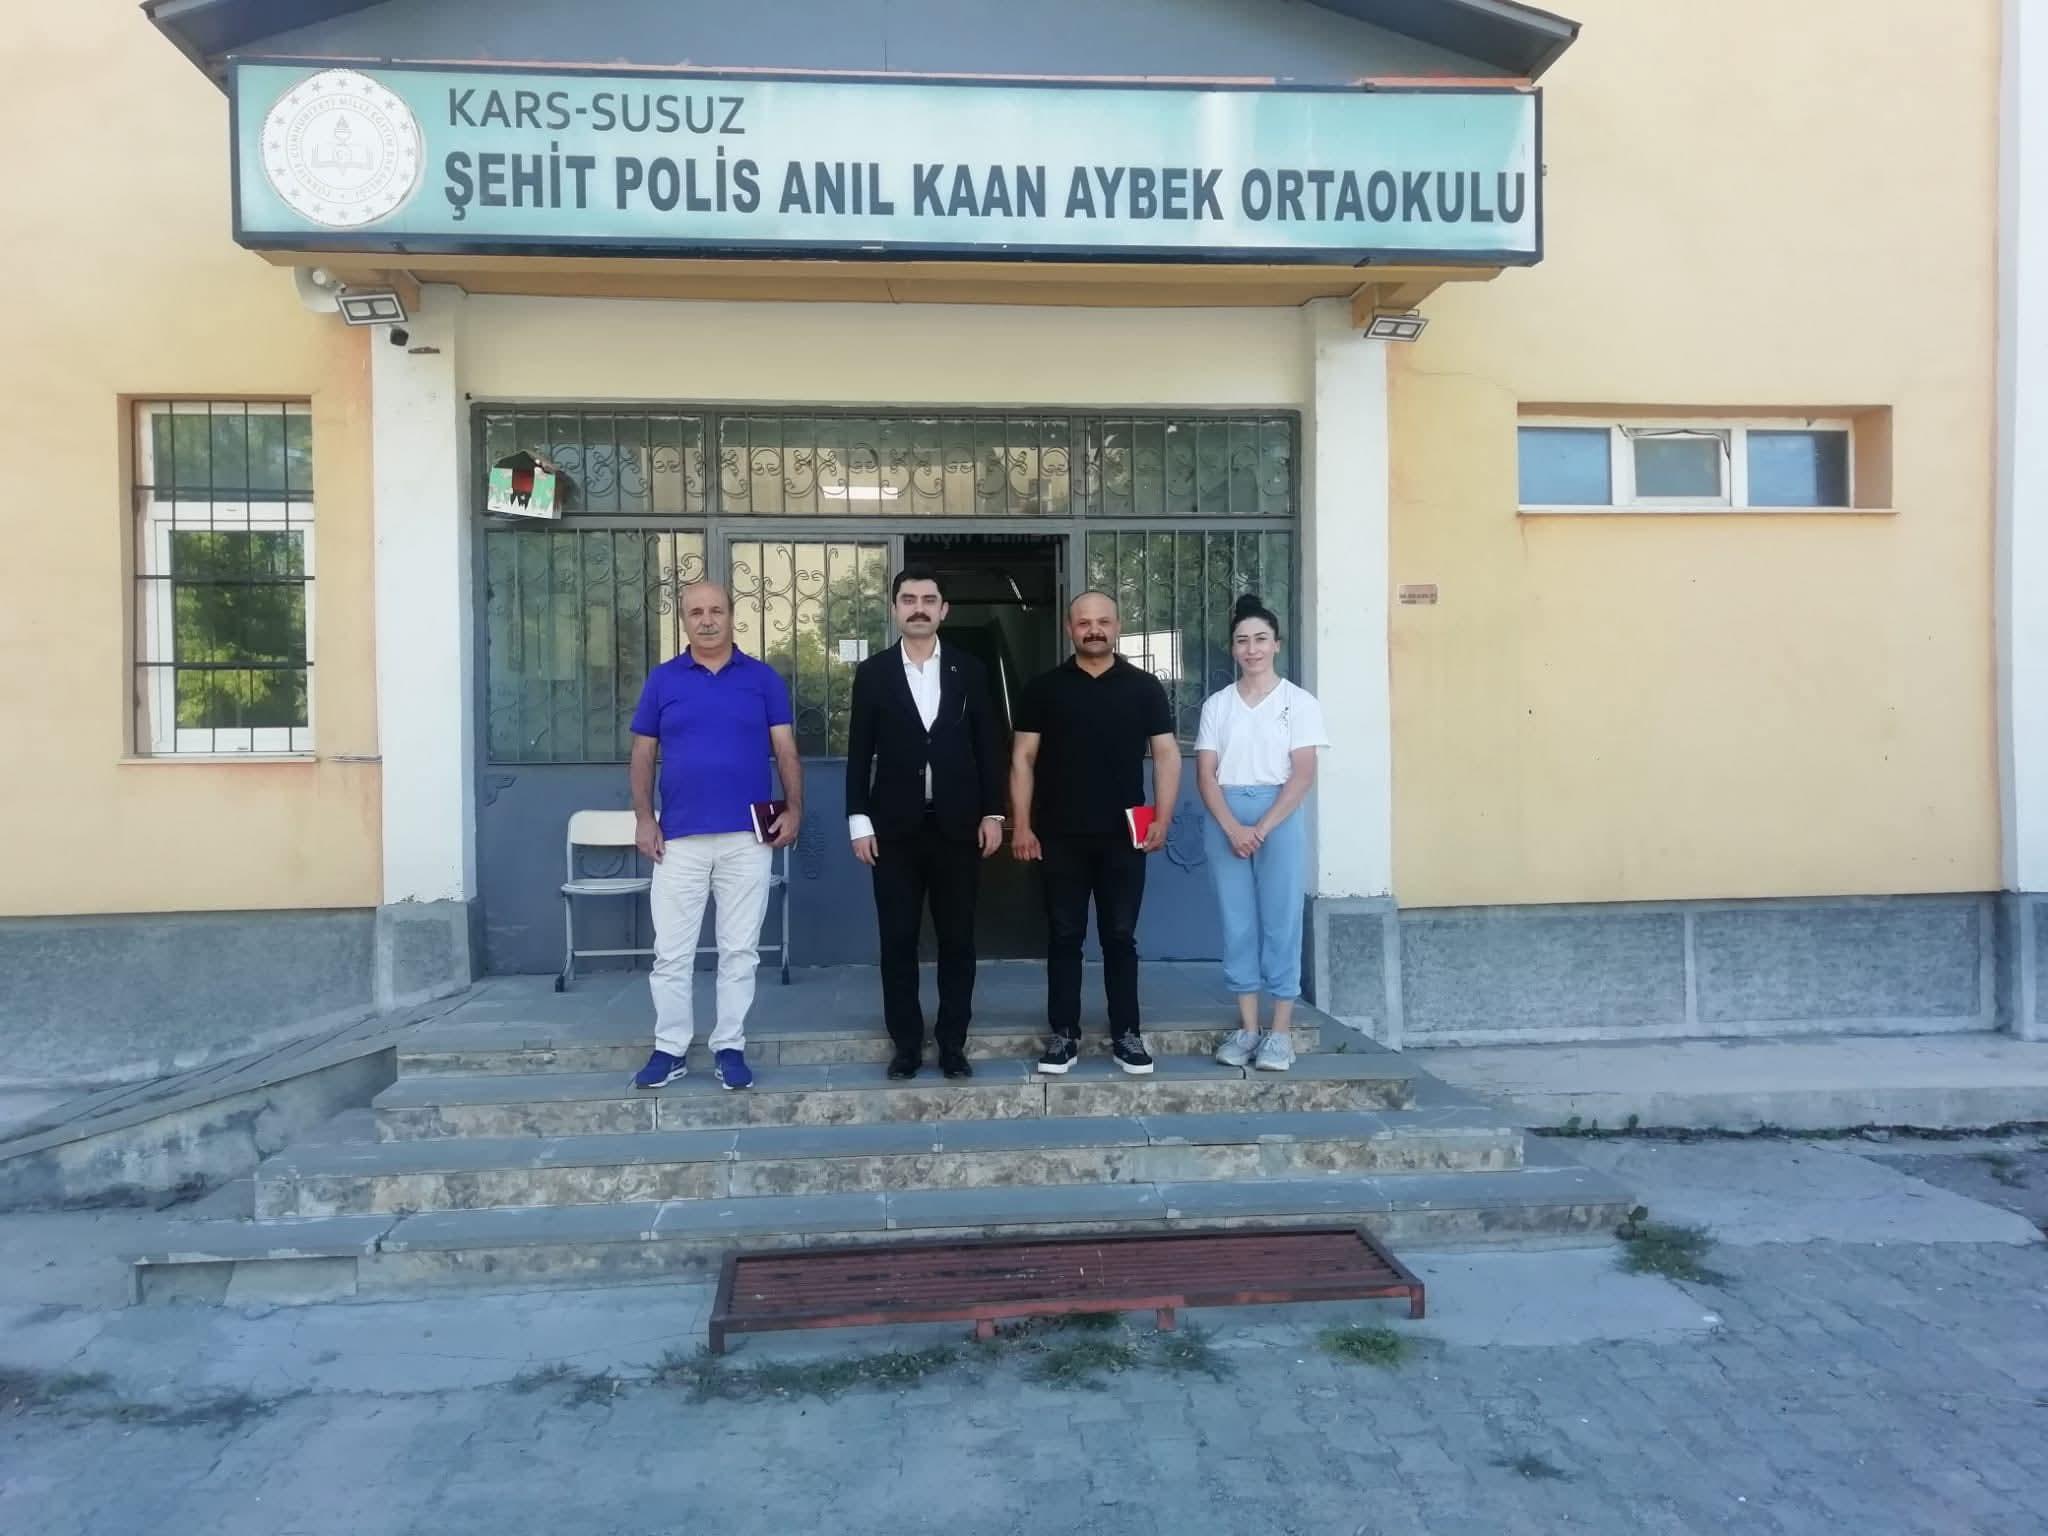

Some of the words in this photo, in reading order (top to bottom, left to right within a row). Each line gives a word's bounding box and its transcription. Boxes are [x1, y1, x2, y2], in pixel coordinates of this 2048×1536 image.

[448, 87, 745, 135] KARS-SUSUZ
[444, 141, 596, 222] ŞEHİT
[615, 146, 761, 214] POLİS
[778, 161, 895, 216] ANIL
[913, 163, 1046, 218] KAAN
[1064, 166, 1224, 220] AYBEK
[1241, 168, 1525, 224] ORTAOKULU
